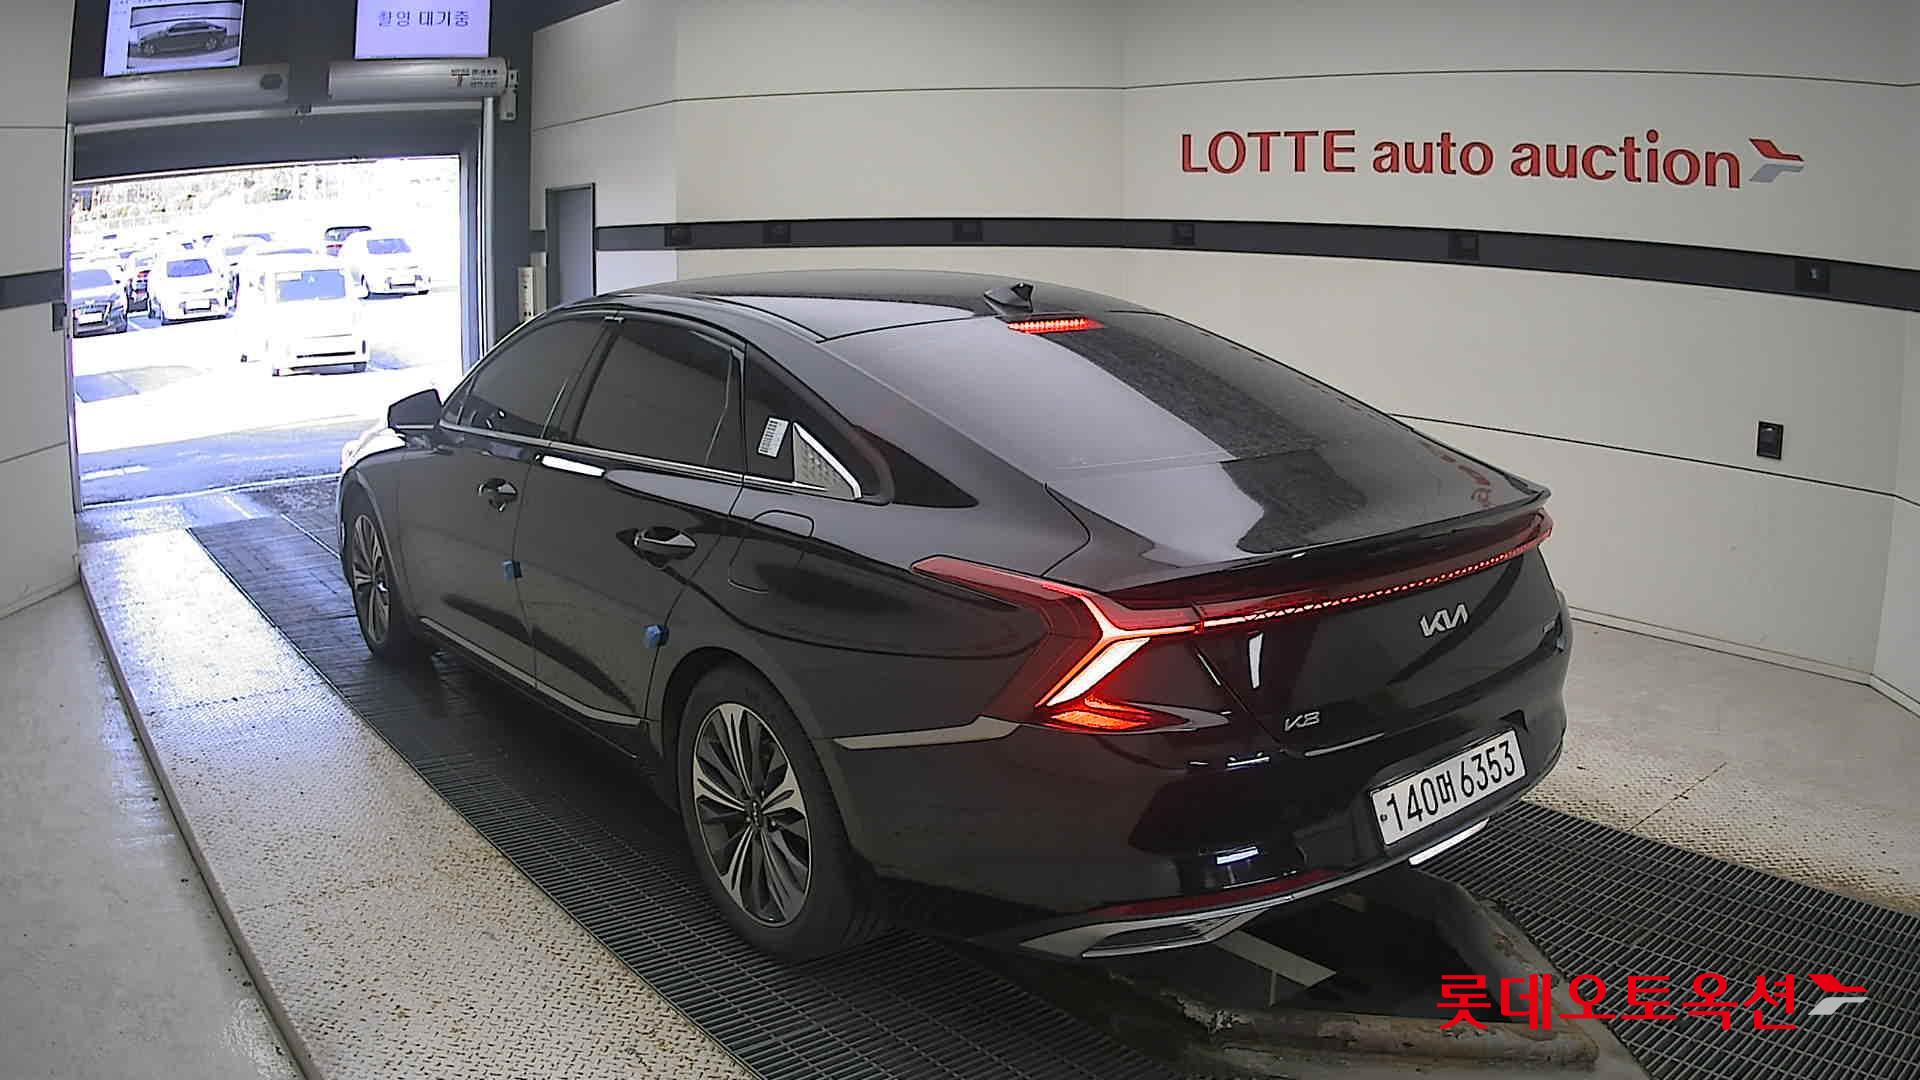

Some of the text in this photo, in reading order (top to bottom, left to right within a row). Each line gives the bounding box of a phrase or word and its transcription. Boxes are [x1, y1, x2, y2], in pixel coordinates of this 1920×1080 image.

[419, 10, 469, 27] 대기중
[1181, 128, 1741, 189] LOTTE auto auction
[1419, 602, 1469, 638] KIA
[1283, 710, 1321, 732] K8
[1459, 740, 1516, 799] 6353
